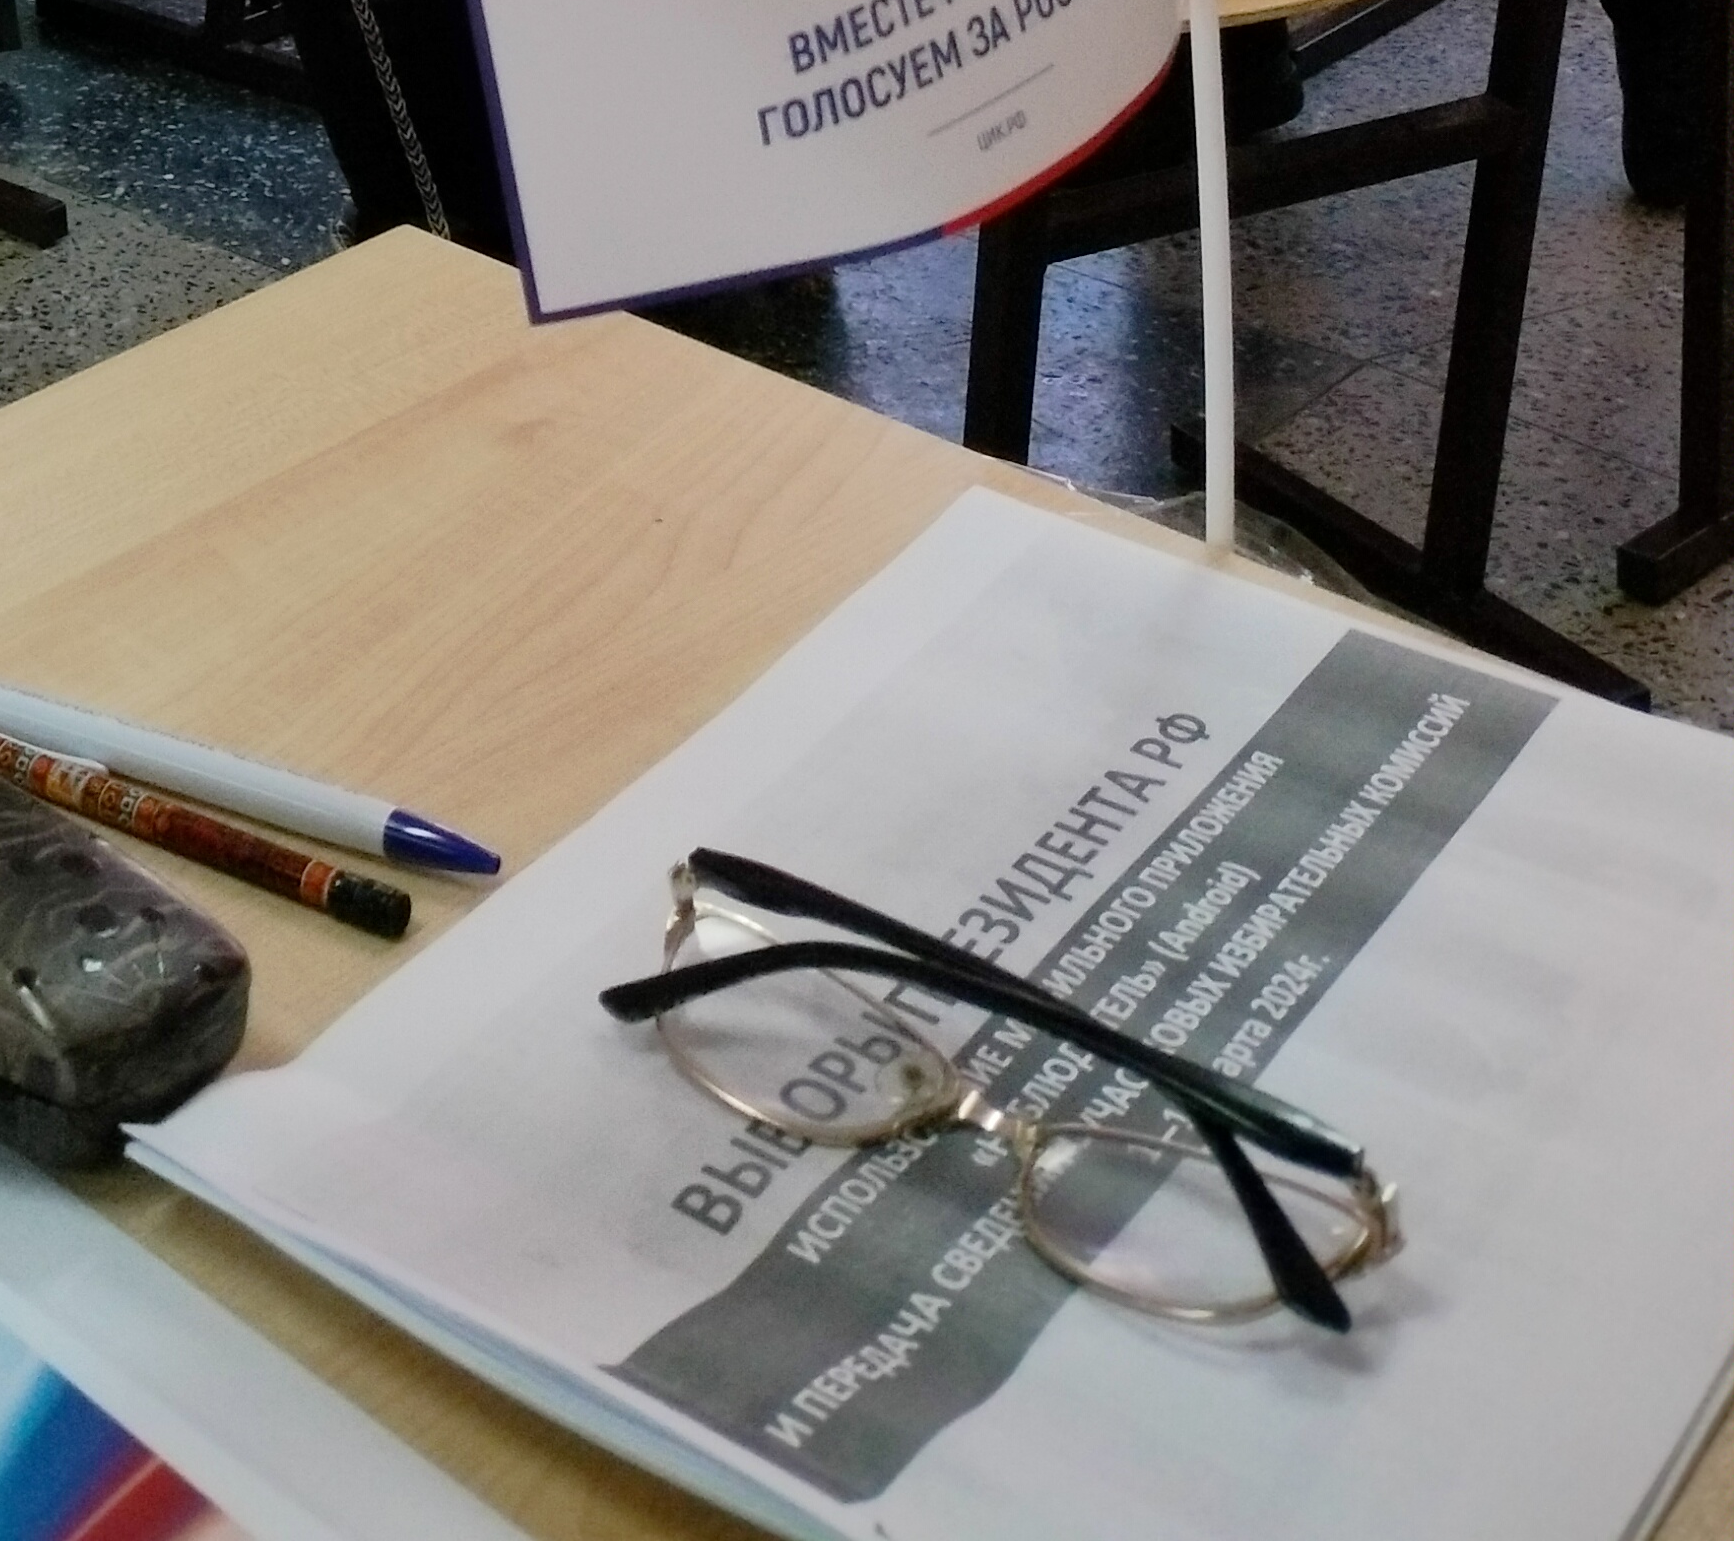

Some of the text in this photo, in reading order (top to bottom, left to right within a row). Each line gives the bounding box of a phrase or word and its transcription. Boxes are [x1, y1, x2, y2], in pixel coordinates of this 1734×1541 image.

[757, 31, 963, 146] ГОЛОСУЕМ
[967, 6, 1012, 57] ЗА
[670, 715, 1209, 1237] ВЫБОРЫ ПЕЗИДЕНТА РФ
[993, 886, 1155, 1048] МИЛЬНОГО
[1140, 748, 1285, 888] ПРИЛОЖЕНИЯ
[1148, 861, 1260, 959] (Android)
[1249, 950, 1330, 1022] 2024г.
[763, 1411, 812, 1447] И
[792, 1291, 952, 1420] ПЕРЕДАЧА
[1209, 798, 1381, 977] ИЗБИРАТЕЛЬНЫХ
[1360, 691, 1470, 804] КОМИССИЙ
